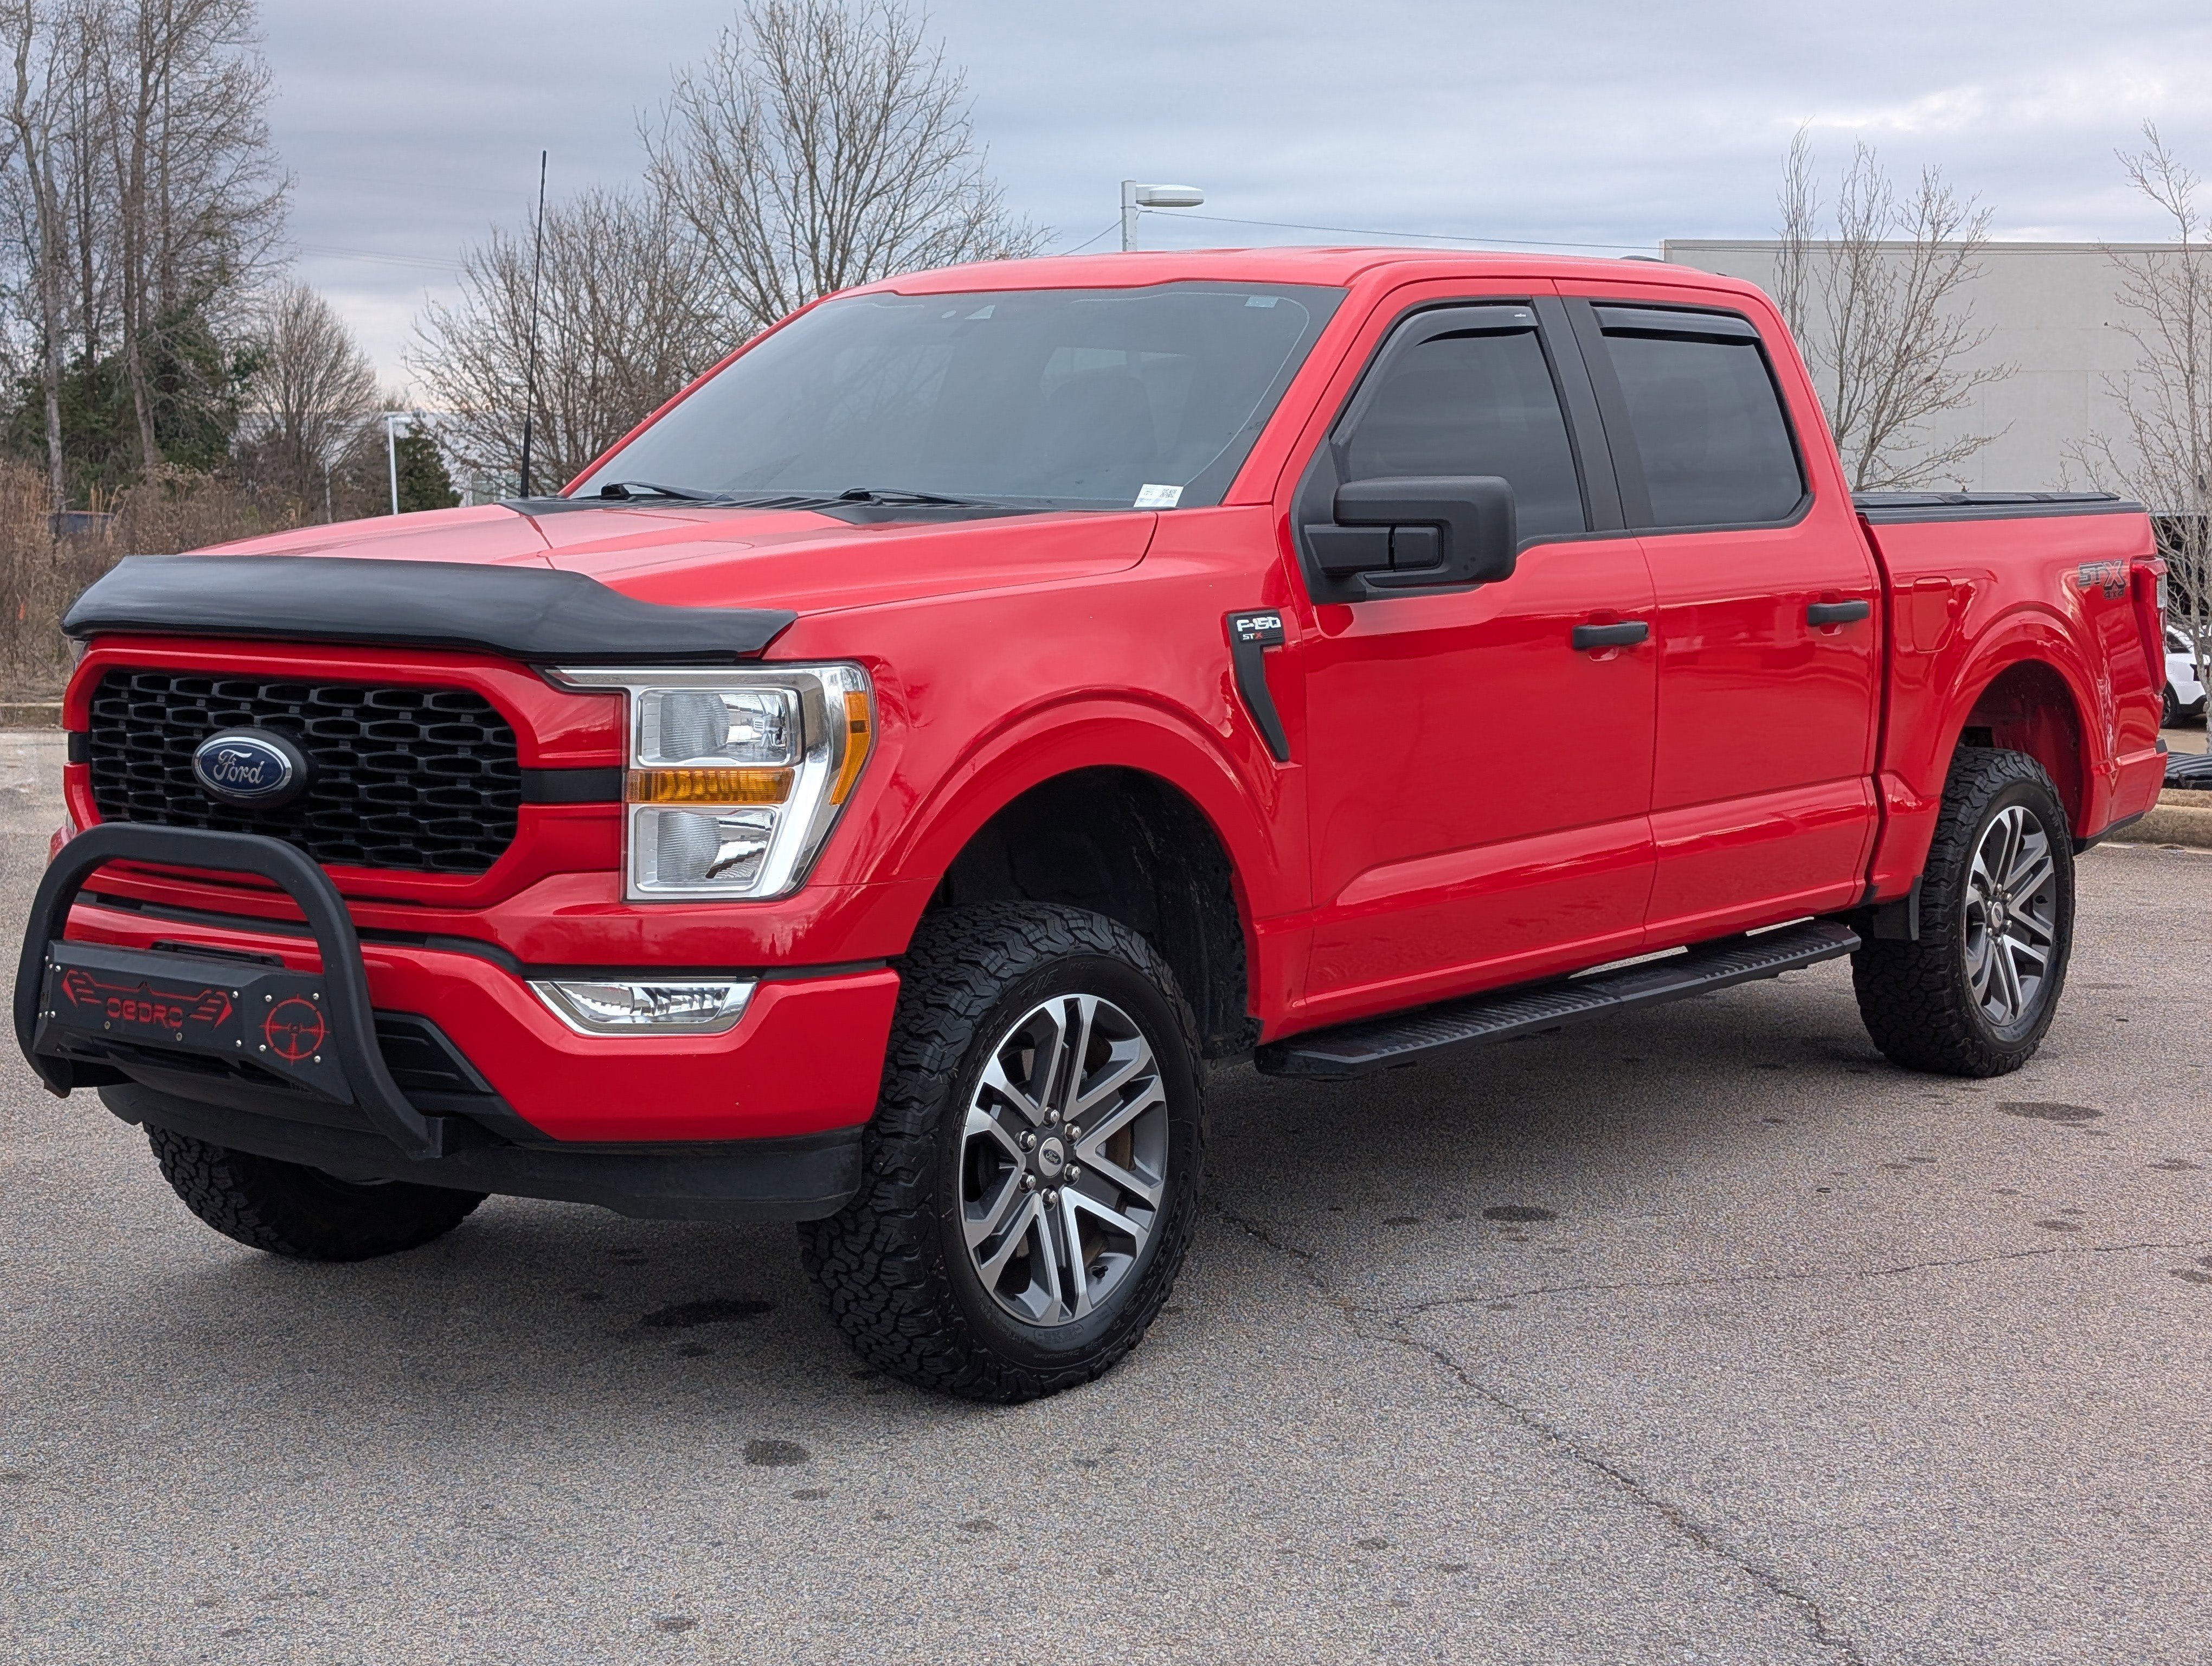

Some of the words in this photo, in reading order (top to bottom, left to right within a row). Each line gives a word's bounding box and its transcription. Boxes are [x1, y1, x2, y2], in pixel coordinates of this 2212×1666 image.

[2077, 559, 2126, 591] STX
[1236, 616, 1281, 632] F-150
[1242, 632, 1263, 640] STX
[213, 748, 265, 784] Ford
